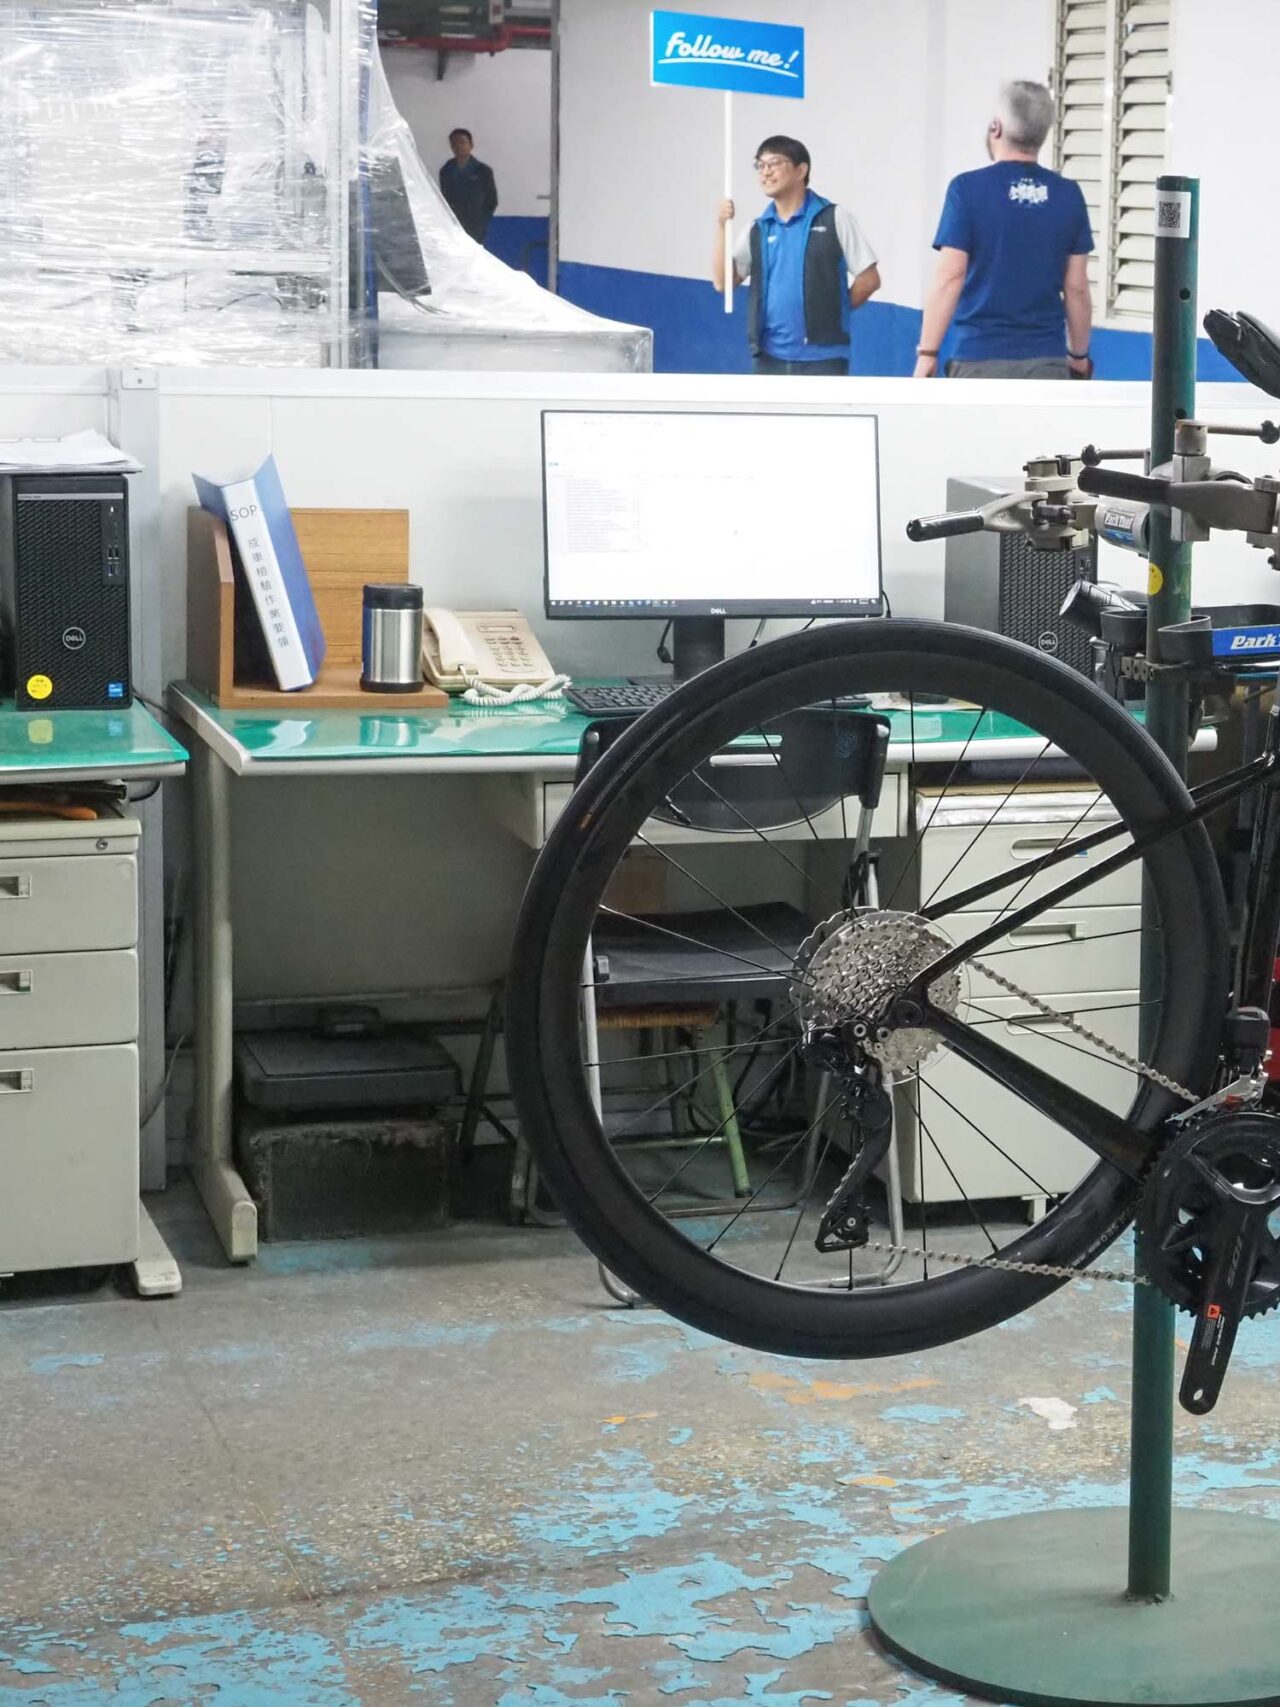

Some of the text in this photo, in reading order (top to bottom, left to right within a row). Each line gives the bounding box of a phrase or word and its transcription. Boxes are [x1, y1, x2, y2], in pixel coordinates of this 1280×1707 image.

[665, 31, 800, 69] Follow me!
[230, 504, 258, 522] SOP
[65, 634, 83, 642] DELL
[1230, 633, 1277, 650] Park
